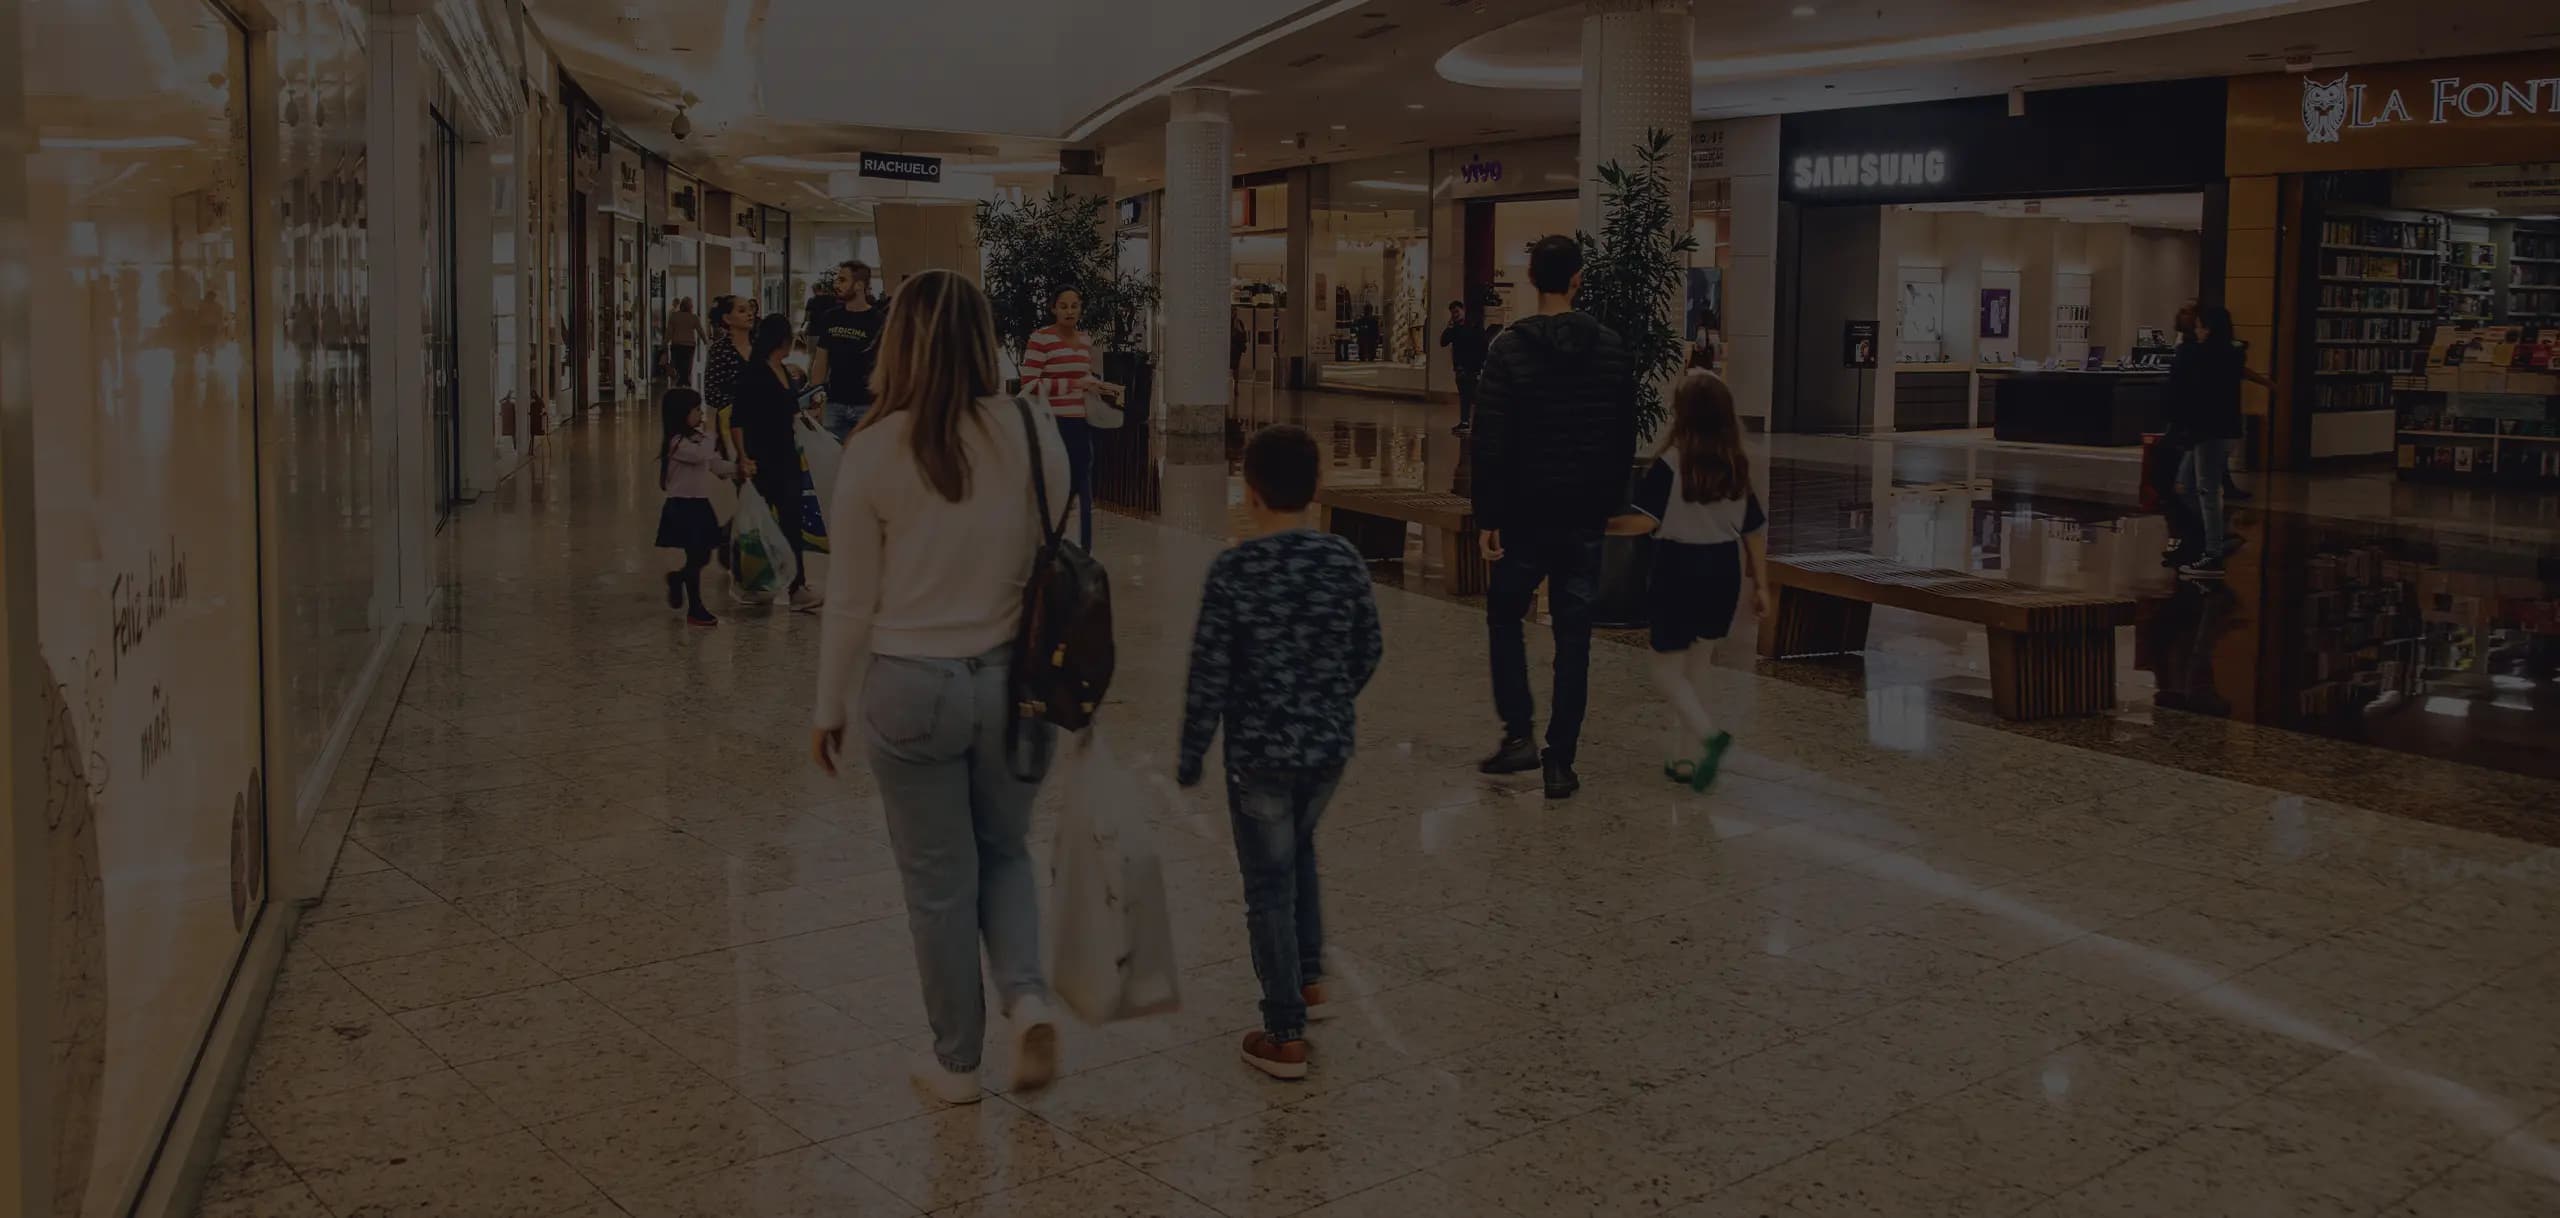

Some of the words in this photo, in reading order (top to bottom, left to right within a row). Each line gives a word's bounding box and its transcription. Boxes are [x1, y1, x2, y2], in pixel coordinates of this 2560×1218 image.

[2348, 84, 2412, 128] LA
[864, 159, 939, 176] RIACHUELO
[1461, 153, 1502, 184] vivo
[1793, 149, 1946, 189] SAMSUNG
[147, 547, 166, 628] dia
